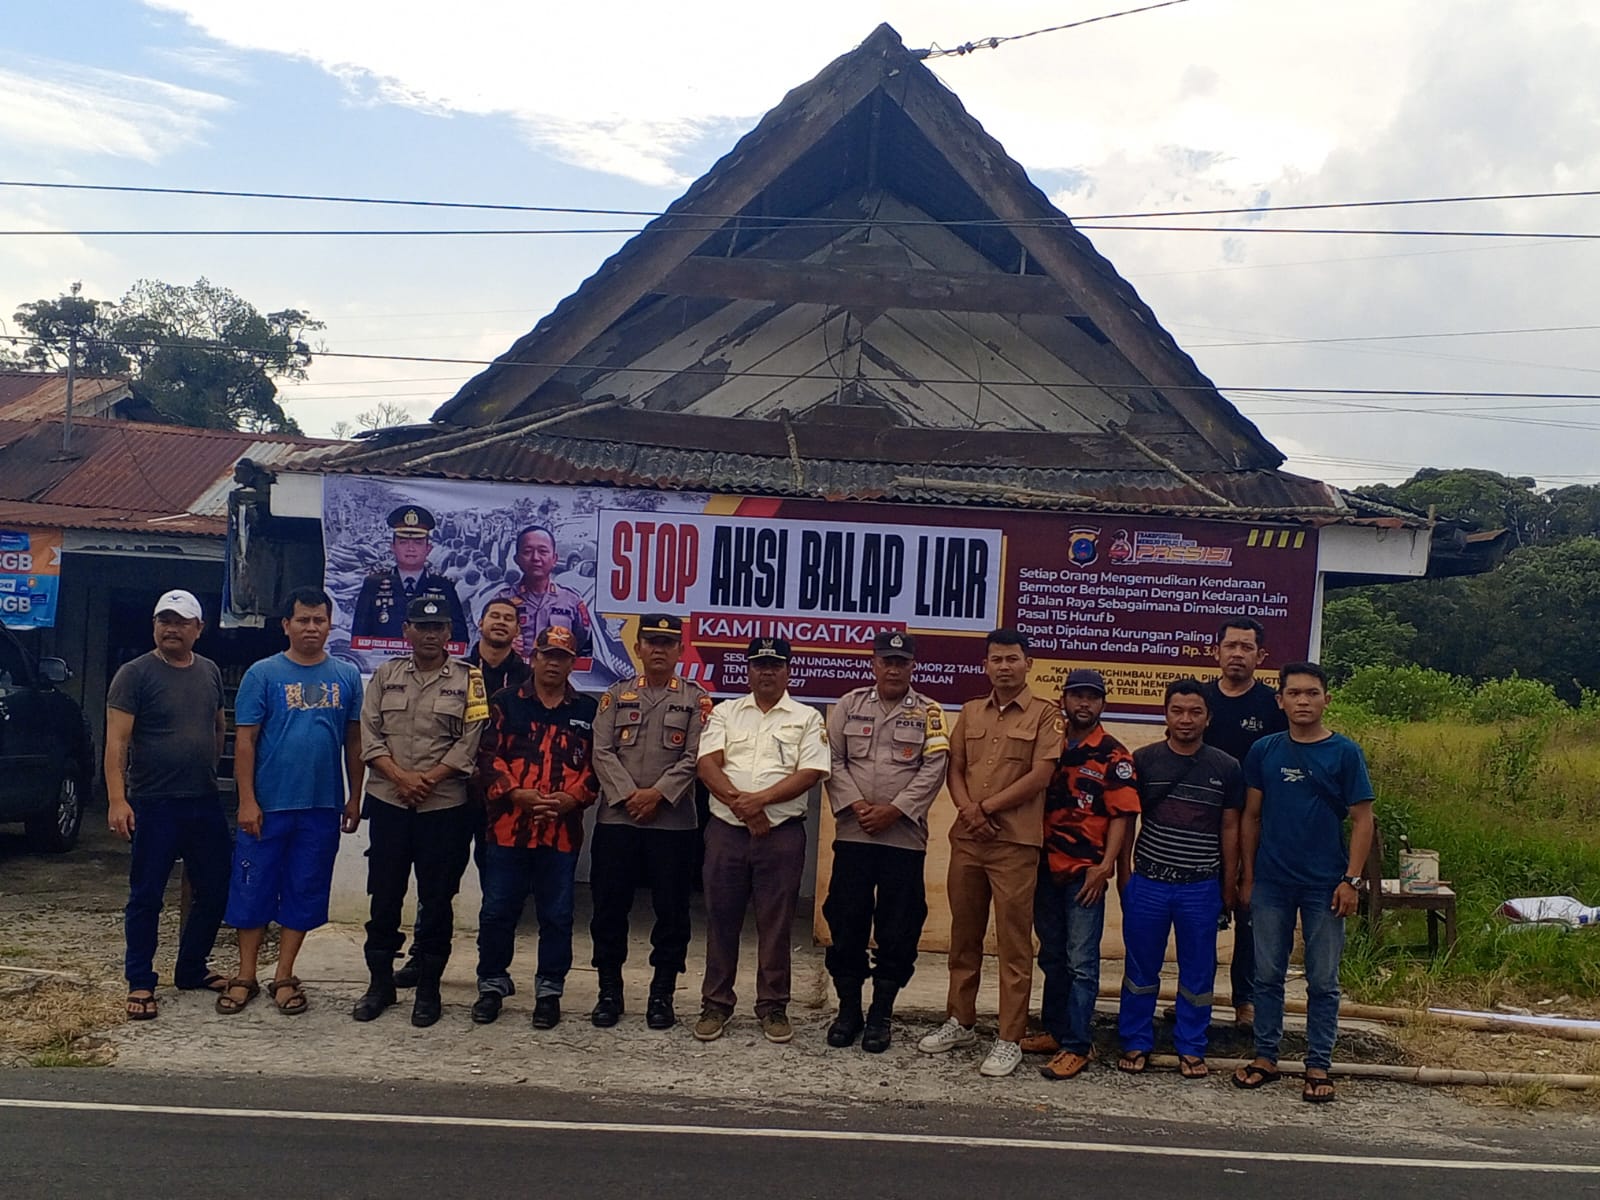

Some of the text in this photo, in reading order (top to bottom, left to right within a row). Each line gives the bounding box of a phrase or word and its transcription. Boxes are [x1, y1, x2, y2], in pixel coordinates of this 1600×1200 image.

[0, 553, 33, 571] GB
[611, 520, 989, 619] STOP AKSI BALAP LIAR
[1019, 568, 1266, 589] Setiap Orang Mengemudikan Kendaraan
[1019, 582, 1288, 604] Bermotor Berbalapan Dengan Kedaraan Lain
[0, 596, 32, 613] GB
[1018, 594, 1288, 617] di Jalan Raya Sebagaimana Dimaksud Dalam
[1017, 609, 1115, 622] Pasal 115 Huruf b
[698, 618, 761, 639] KAMI
[1017, 623, 1053, 635] Dapat
[1055, 624, 1110, 638] Dipidana
[1112, 628, 1173, 641] Kurungan
[1175, 631, 1213, 644] Paling
[1028, 637, 1057, 651] Satu)
[1059, 639, 1098, 650] Tahun
[1100, 641, 1139, 653] denda
[1141, 643, 1179, 656] Paling
[1182, 645, 1201, 657] Rp.
[723, 652, 749, 662] SESU
[943, 664, 956, 673] 22
[958, 665, 986, 674] TAHU
[722, 675, 749, 687] (LLAJ
[800, 668, 835, 678] LINTAS
[837, 670, 860, 679] DAN
[920, 674, 953, 684] JALAN
[1035, 675, 1063, 683] AGAR
[1117, 679, 1138, 687] DAN
[1116, 687, 1163, 697] TERLIBAT
